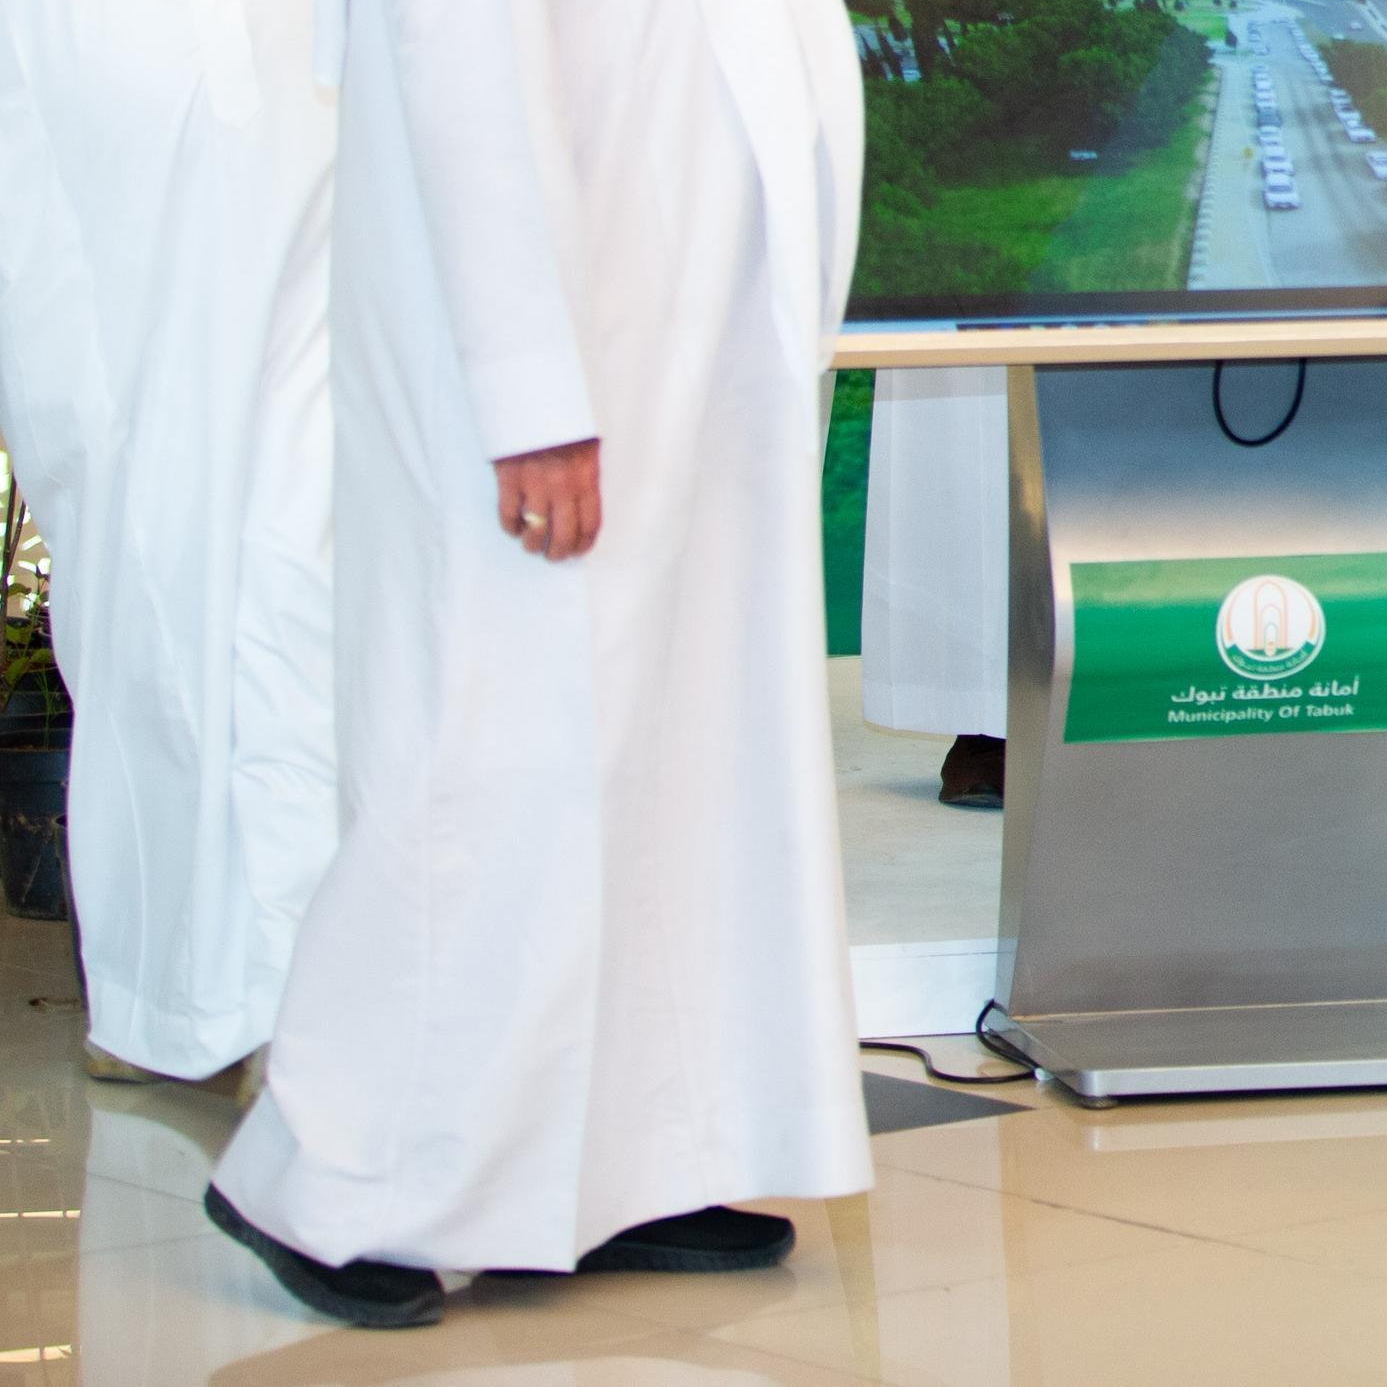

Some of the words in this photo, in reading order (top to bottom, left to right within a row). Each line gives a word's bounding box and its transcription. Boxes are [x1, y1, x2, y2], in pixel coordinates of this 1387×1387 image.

[1171, 685, 1225, 707] تبوك
[1231, 682, 1302, 701] منطقة
[1309, 675, 1360, 699] أمانة
[1168, 706, 1273, 724] Municipality
[1279, 705, 1300, 719] Of
[1306, 703, 1355, 718] Tabuk
